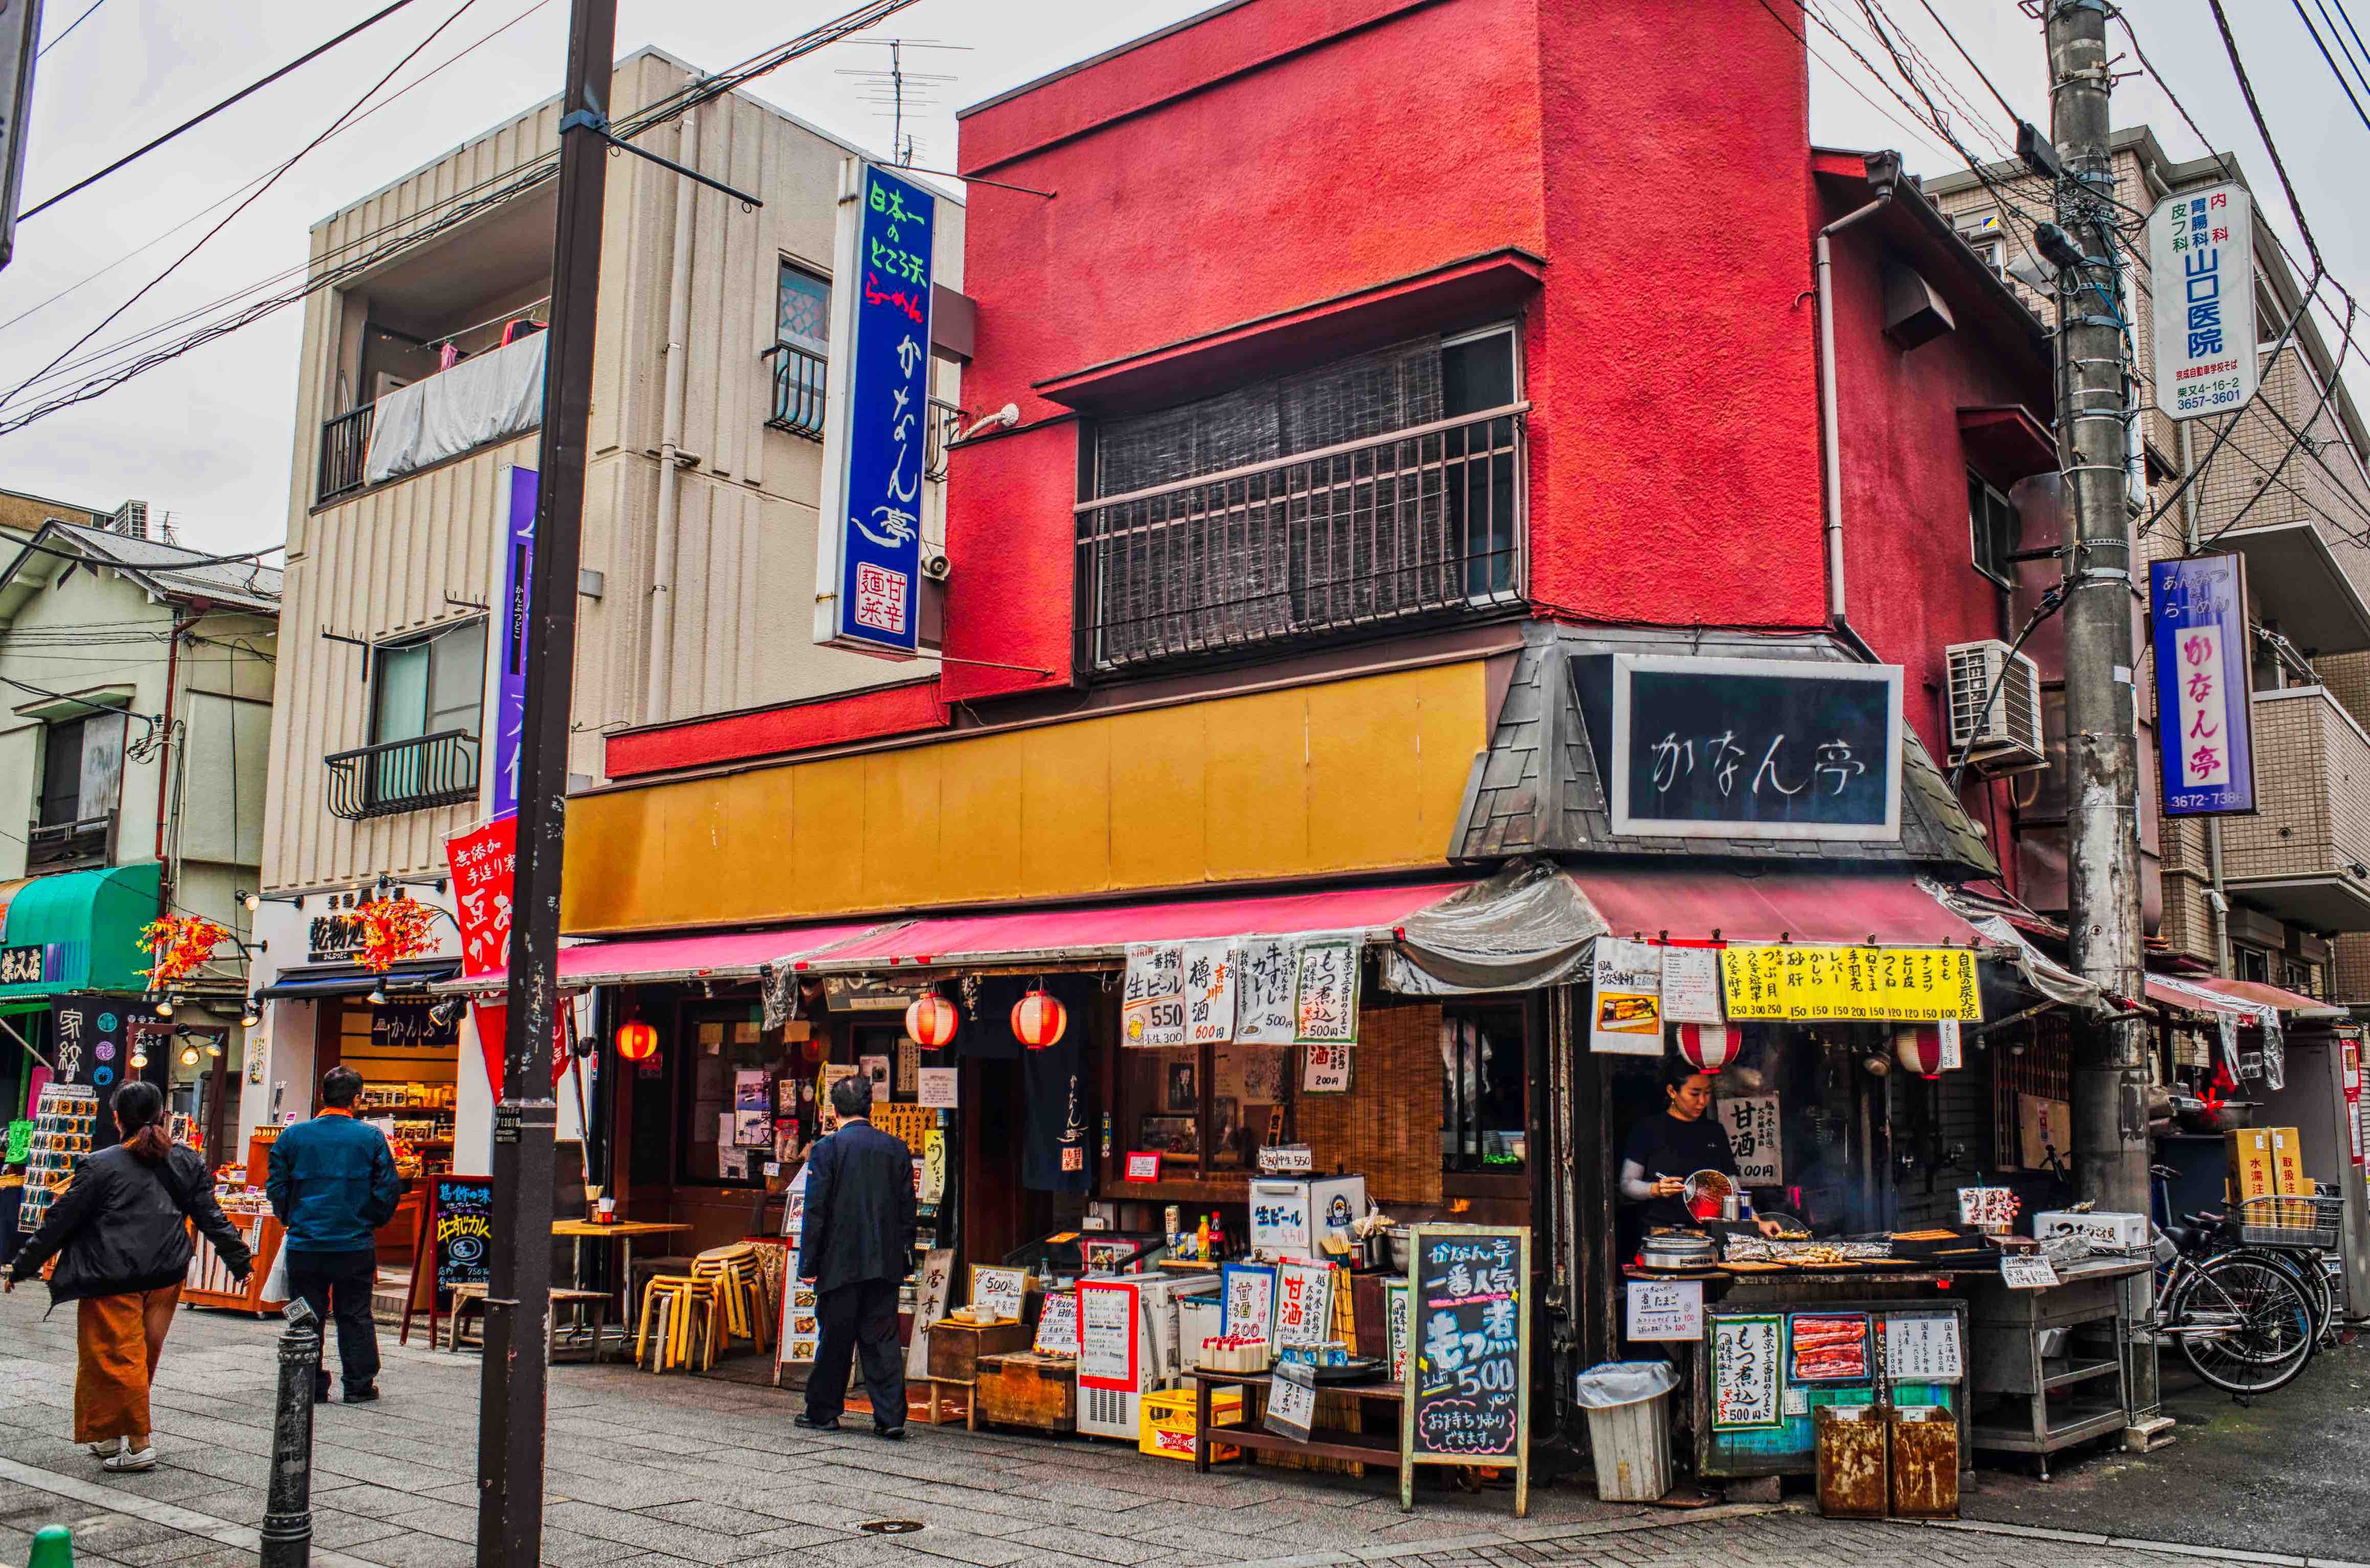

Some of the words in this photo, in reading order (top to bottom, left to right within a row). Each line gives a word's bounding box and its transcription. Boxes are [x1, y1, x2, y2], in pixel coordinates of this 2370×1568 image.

[870, 180, 925, 225] 日本一
[887, 223, 899, 243] の
[2171, 204, 2189, 253] 皮フ科
[2190, 197, 2208, 249] 胃腸科
[2210, 193, 2228, 243] 内科
[871, 236, 927, 288] ところ天
[865, 271, 923, 323] らーめん
[2184, 249, 2223, 359] 山口医院
[2176, 360, 2238, 381] 京成自動車学校そば
[2177, 377, 2240, 398] 柴又4-16-2
[2178, 389, 2240, 410] 3657-3601
[851, 334, 922, 548] かなん亭
[2163, 569, 2229, 591] あんみつ
[884, 574, 907, 631] 甘辛
[2163, 597, 2229, 618] らーめん
[2183, 634, 2221, 780] かなん亭
[1650, 732, 1865, 797] かなん亭
[455, 839, 501, 868] 無添加
[461, 887, 495, 972] 豆か
[1131, 947, 1154, 958] KIRIN
[1146, 950, 1181, 969] 一番搾り
[1598, 960, 1613, 971] 国産
[1830, 951, 1843, 984] レバー
[1941, 954, 1951, 981] もも
[1252, 957, 1267, 1009] カレー
[1265, 943, 1282, 1005] 牛すじ
[1280, 958, 1289, 1000] ごはん半分
[1727, 951, 1742, 1000] うなぎ肝串
[1747, 950, 1762, 1003] うなぎ短冊串
[1763, 951, 1778, 998] つぶ貝
[1786, 951, 1805, 988] 砂肝
[1809, 952, 1824, 985] かしら
[1847, 949, 1863, 993] 手羽先
[1865, 952, 1877, 992] ねぎま
[1883, 954, 1897, 989] つくね
[1903, 954, 1915, 989] とり皮
[1921, 954, 1934, 993] ナンコツ
[1126, 973, 1182, 1000] 生ビール
[1189, 956, 1211, 1022] 樽酒
[1312, 950, 1337, 1023] もつ煮込
[1339, 948, 1353, 1035] 東京で二番目のうまさ
[1957, 952, 1979, 1019] 自慢の炭火焼
[1151, 1004, 1183, 1027] 550
[1265, 1013, 1293, 1028] 500円
[1731, 1005, 1748, 1015] 250
[1751, 1004, 1765, 1015] 300
[1767, 1004, 1782, 1014] 250
[1791, 1006, 1807, 1017] 150
[1812, 1005, 1828, 1016] 150
[1834, 1005, 1849, 1016] 150
[1851, 1006, 1866, 1018] 200
[1869, 1006, 1885, 1017] 150
[1888, 1008, 1902, 1018] 120
[1905, 1010, 1919, 1019] 120
[1922, 1010, 1937, 1019] 150
[1941, 1009, 1962, 1018] 100
[58, 1009, 82, 1072] 家紋
[1145, 1033, 1161, 1044] 小生
[1164, 1032, 1182, 1044] 300
[1195, 1024, 1224, 1039] 600円
[1309, 1025, 1338, 1037] 500円
[1315, 1076, 1338, 1085] 200円
[1730, 1101, 1756, 1157] 甘酒
[926, 1135, 944, 1193] うなぎ
[1279, 1156, 1291, 1164] 中生
[1294, 1156, 1310, 1166] 550
[439, 1182, 491, 1203] 葛飾の味
[1255, 1203, 1303, 1227] 生ビール
[1332, 1217, 1348, 1226] KIRIN
[986, 1276, 1008, 1291] 500
[1425, 1263, 1518, 1297] 一番人気
[921, 1268, 945, 1343] 営業中
[1233, 1281, 1252, 1318] 甘酒
[1283, 1273, 1305, 1327] 甘酒
[1654, 1292, 1679, 1307] たまご
[1232, 1323, 1260, 1337] 200
[1425, 1298, 1518, 1372] もつ煮
[1675, 1324, 1686, 1332] 100
[1457, 1357, 1515, 1397] 500
[1732, 1325, 1760, 1405] もつ煮込
[1762, 1324, 1774, 1417] 東京で二番目のうまさ
[1281, 1382, 1293, 1414] ワンカップ
[1487, 1393, 1516, 1412] yen
[1428, 1411, 1506, 1430] お持ち帰り
[1729, 1407, 1761, 1421] 500円
[1444, 1430, 1495, 1446] できます。
